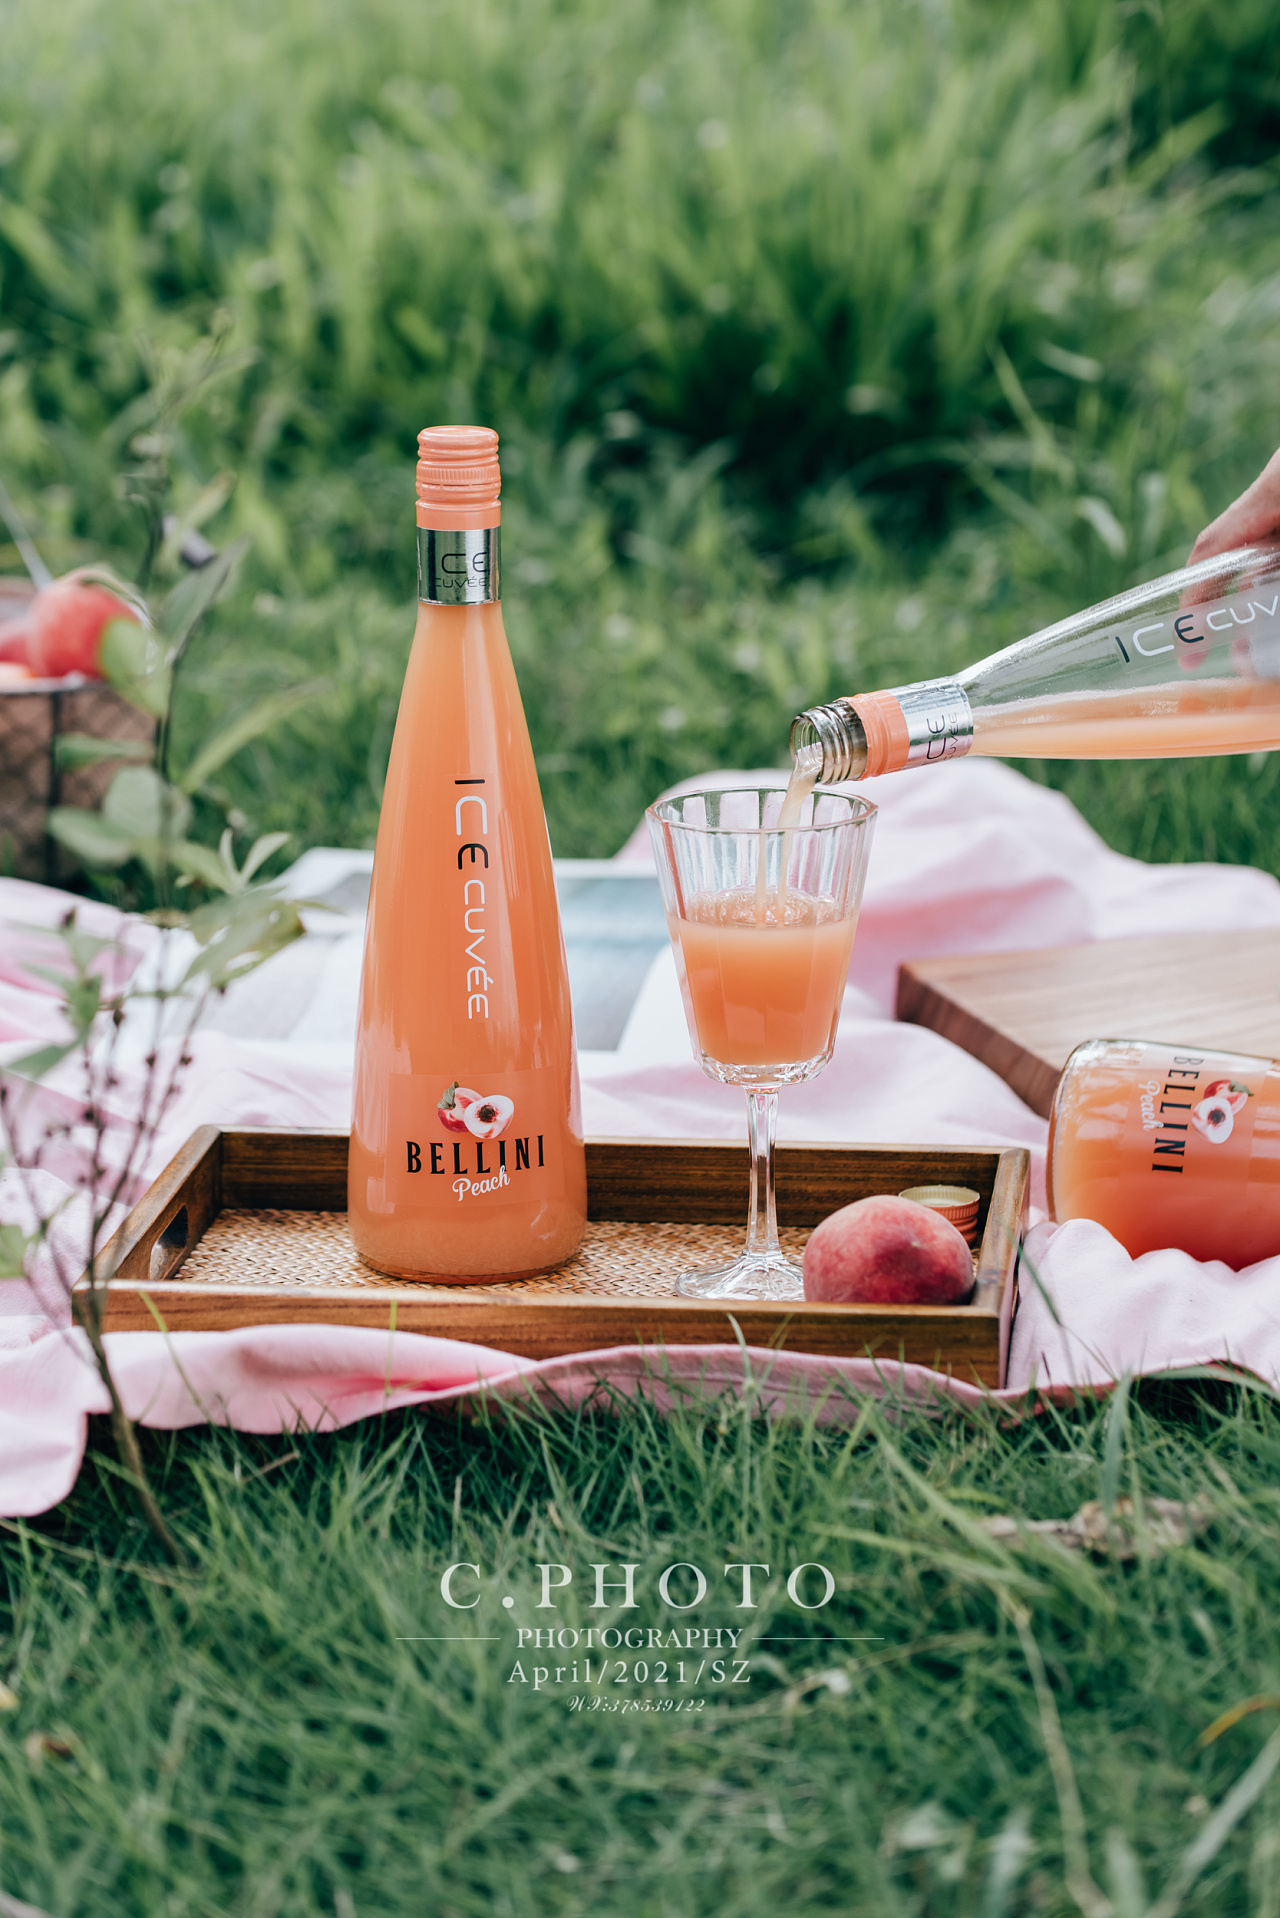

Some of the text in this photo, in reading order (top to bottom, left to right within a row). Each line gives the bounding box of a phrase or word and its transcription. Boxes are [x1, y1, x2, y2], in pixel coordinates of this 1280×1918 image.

[1114, 613, 1205, 664] ICE
[454, 778, 495, 1019] ICE CUVÉE
[1138, 1080, 1165, 1132] Peach
[1151, 1055, 1205, 1174] BELLINI
[406, 1134, 545, 1175] BELLINI
[452, 1164, 511, 1202] Peach
